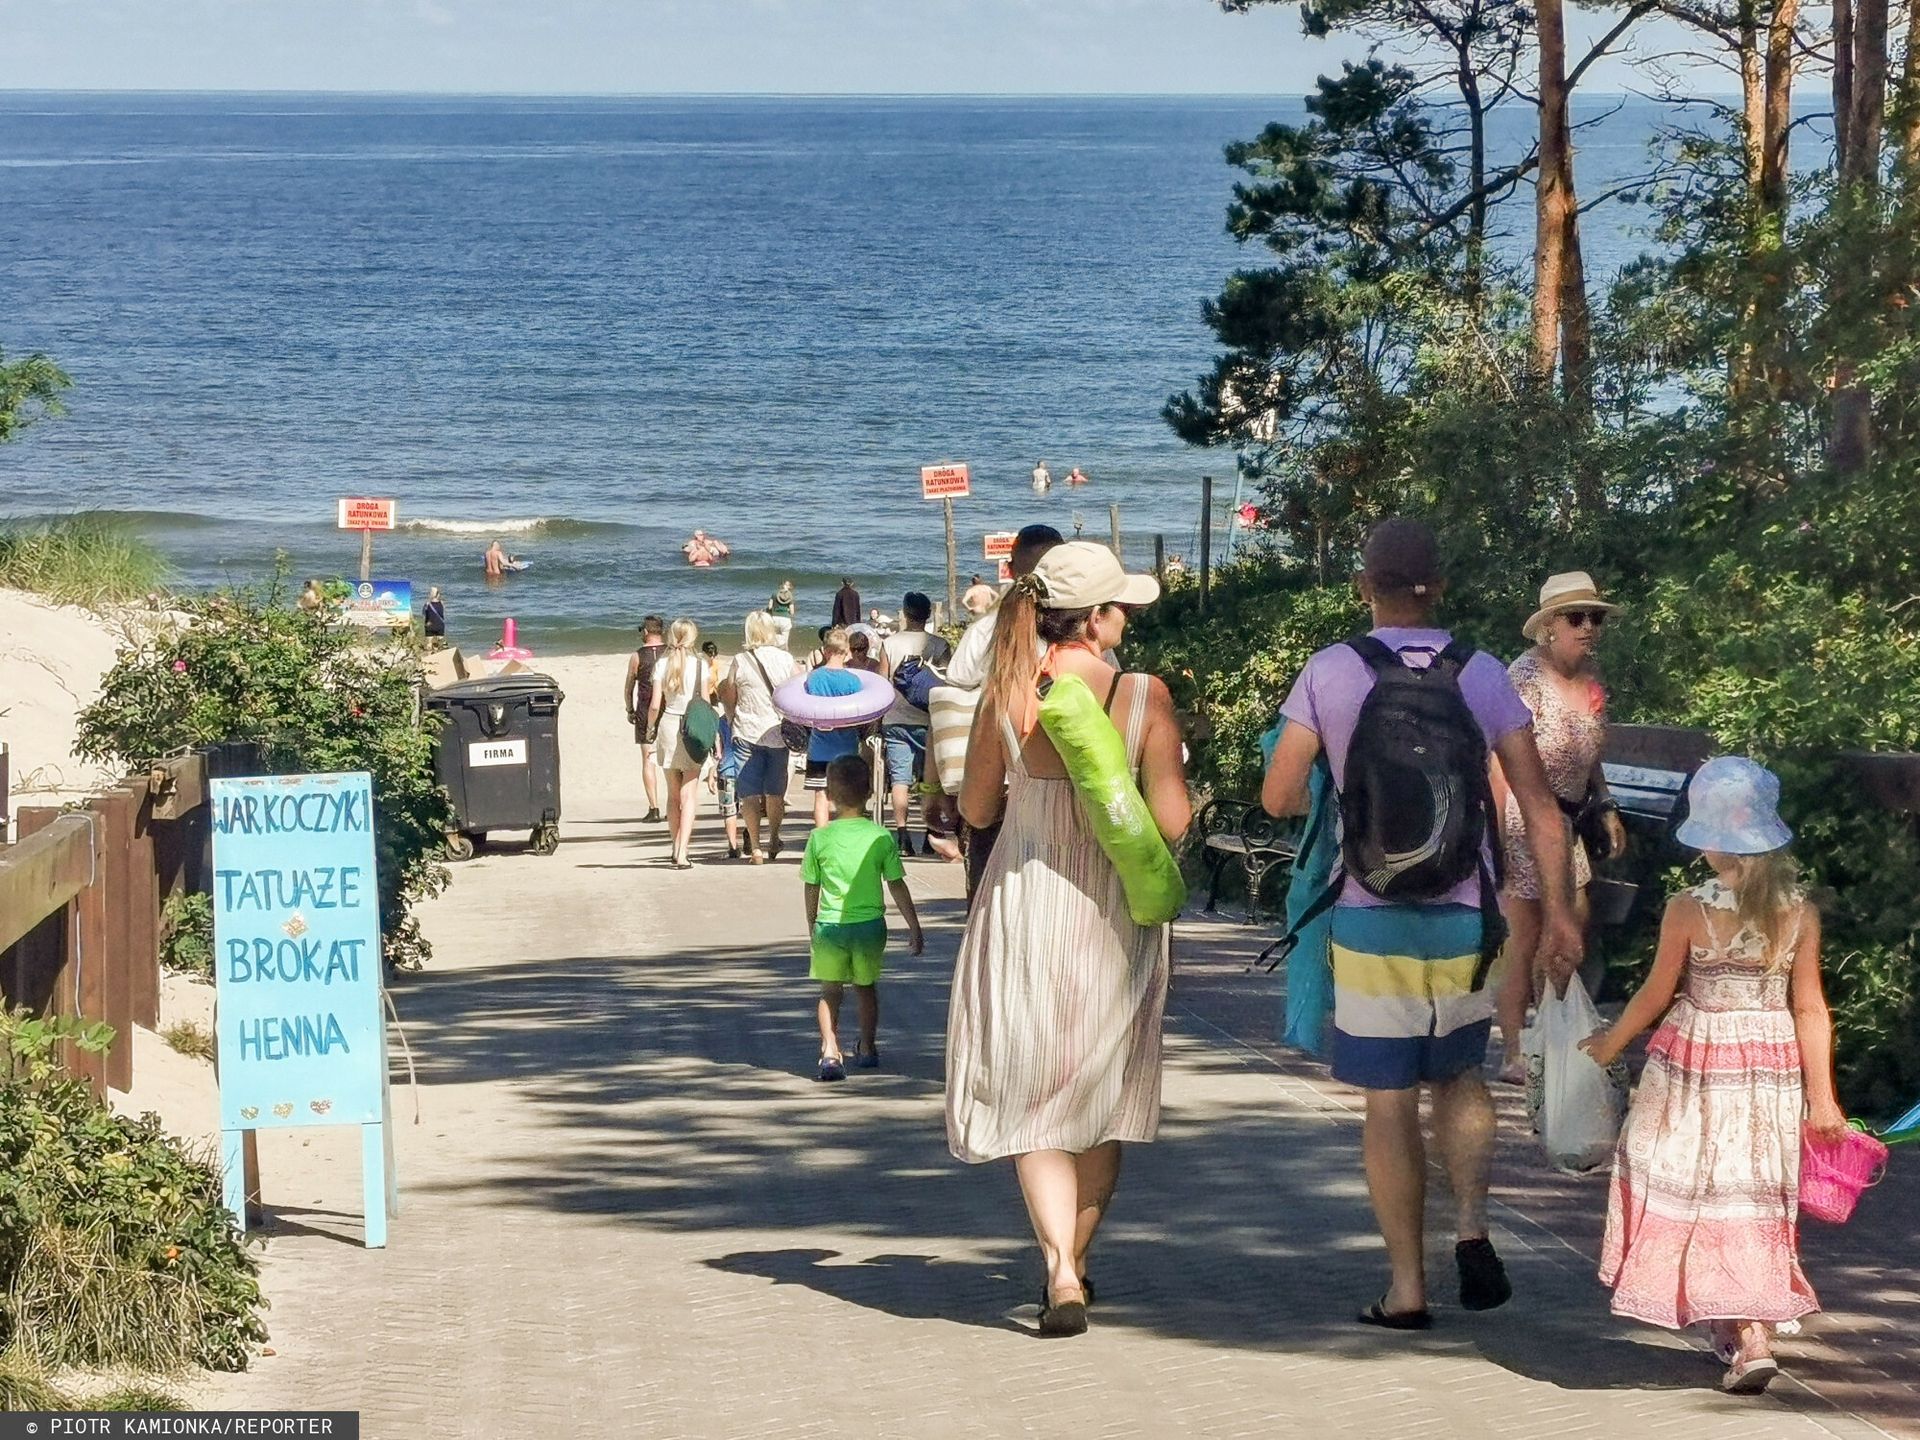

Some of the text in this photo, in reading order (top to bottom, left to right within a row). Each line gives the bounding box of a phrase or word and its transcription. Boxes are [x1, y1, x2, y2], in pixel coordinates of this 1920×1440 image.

[933, 469, 955, 478] DROGA
[925, 476, 965, 487] RATUNKOWA
[356, 502, 379, 510] DROGA
[347, 510, 388, 519] RATUNKOWA
[484, 748, 514, 759] FIRMA
[212, 789, 371, 836] WARKOCZYKI
[226, 937, 366, 985] BROKAT
[239, 1013, 351, 1061] HENNA
